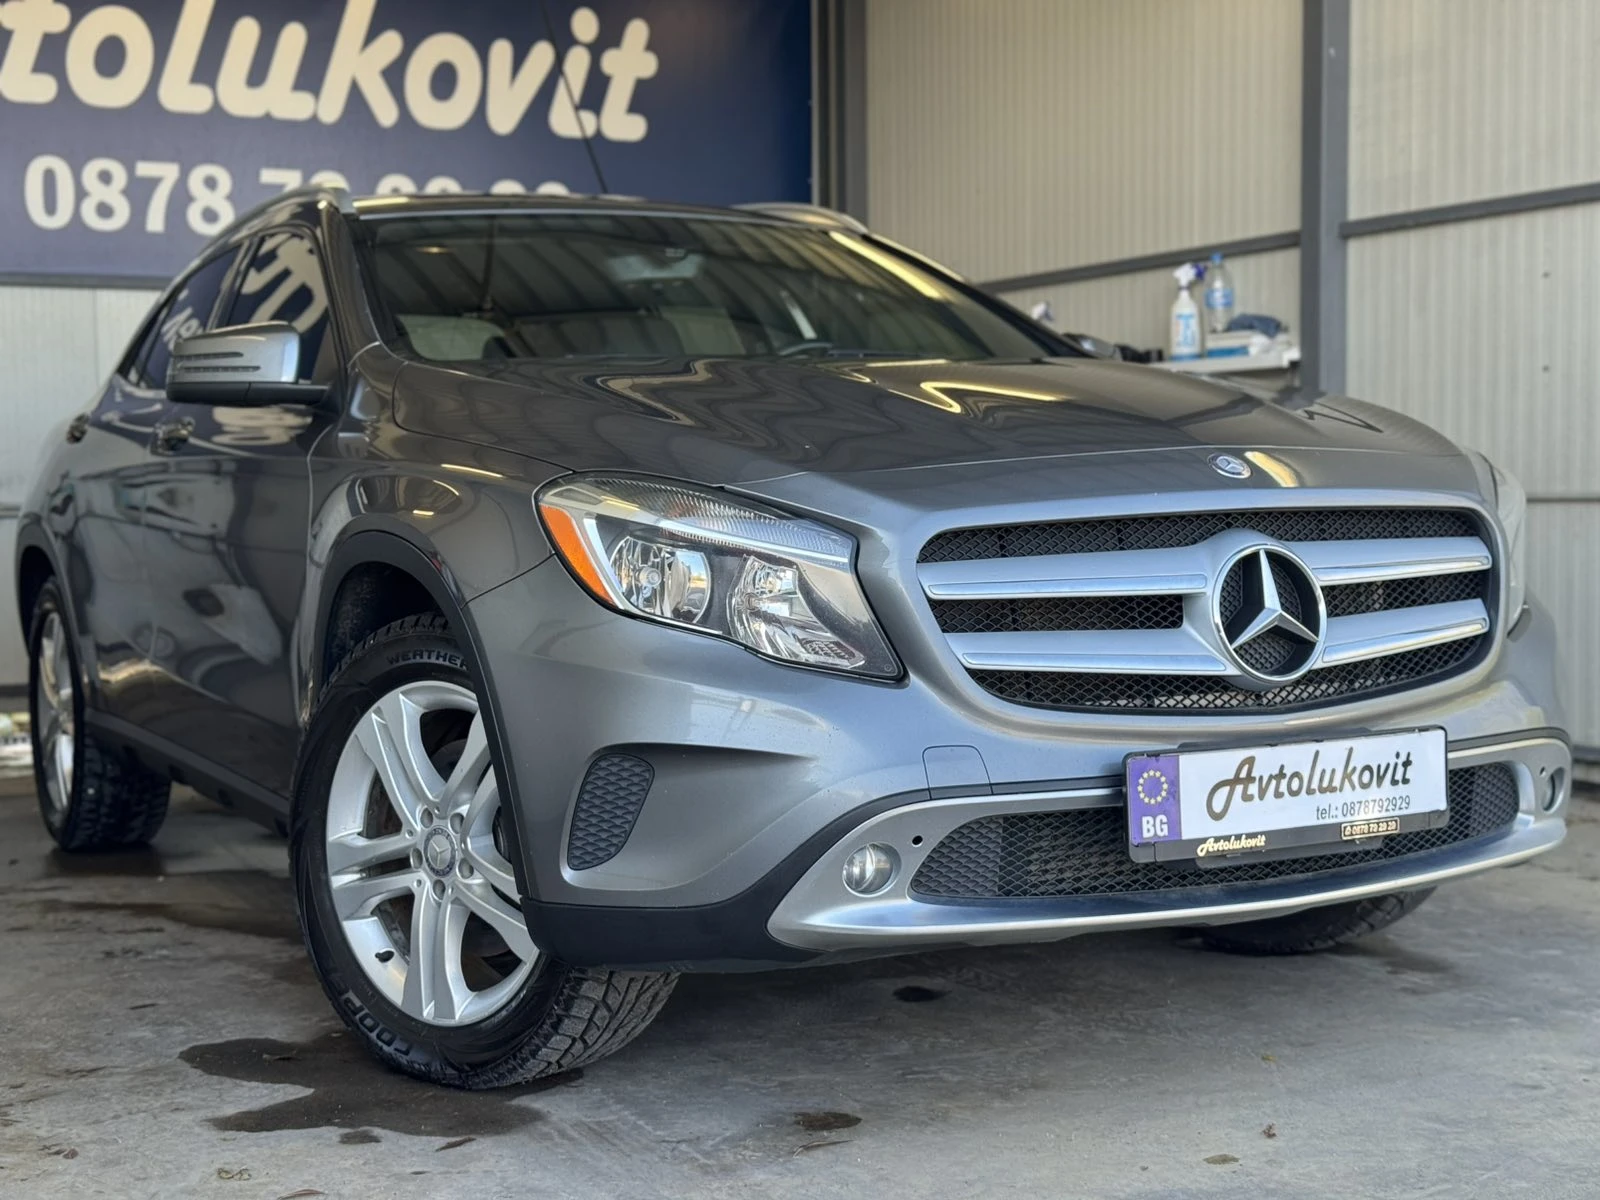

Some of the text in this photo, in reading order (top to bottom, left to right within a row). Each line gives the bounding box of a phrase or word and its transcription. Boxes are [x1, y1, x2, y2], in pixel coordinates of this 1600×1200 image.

[24, 154, 236, 237] 0878
[1206, 747, 1412, 820] Avtolukovit
[1341, 795, 1410, 817] 0878792929
[1142, 816, 1168, 838] BG
[1197, 834, 1266, 857] Avtolukovit
